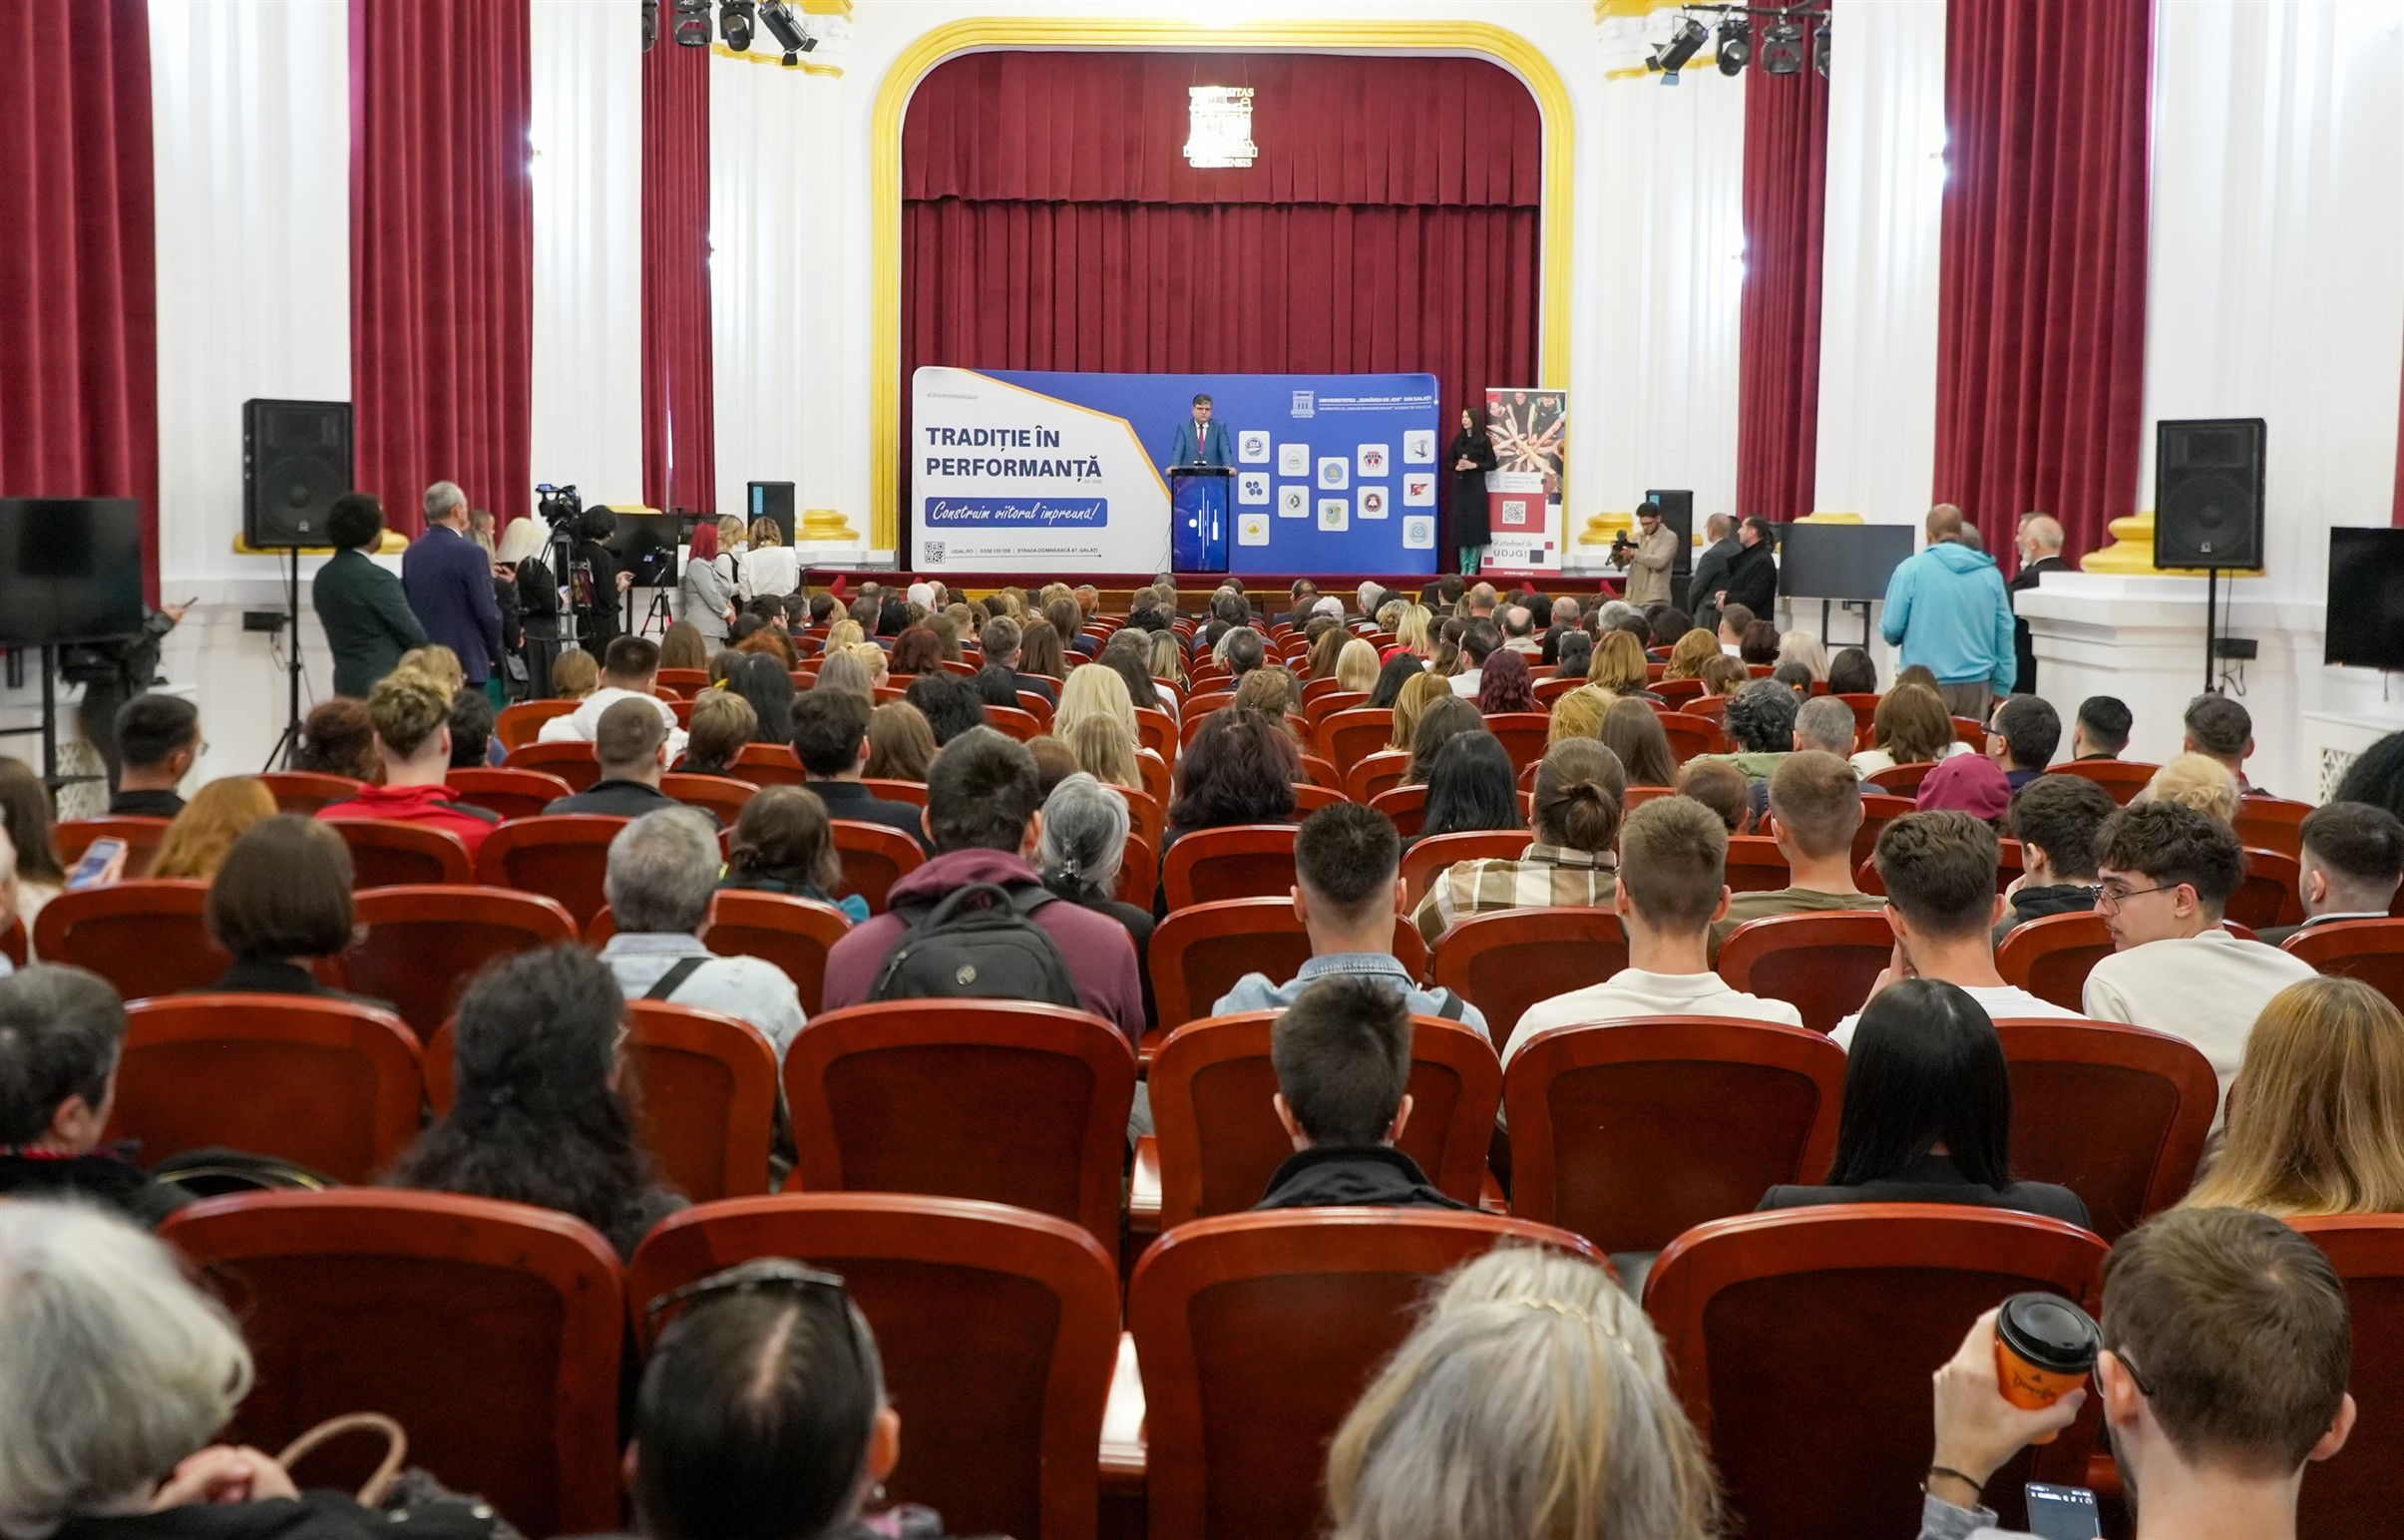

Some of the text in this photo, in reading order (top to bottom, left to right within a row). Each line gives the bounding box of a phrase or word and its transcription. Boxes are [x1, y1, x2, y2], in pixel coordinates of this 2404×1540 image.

[926, 425, 1060, 452] TRADIȚIE ÎN
[926, 455, 1102, 482] PERFORMANȚĂ
[933, 501, 1100, 526] Construim viitorul împreună!
[1493, 549, 1527, 558] UDJG!
